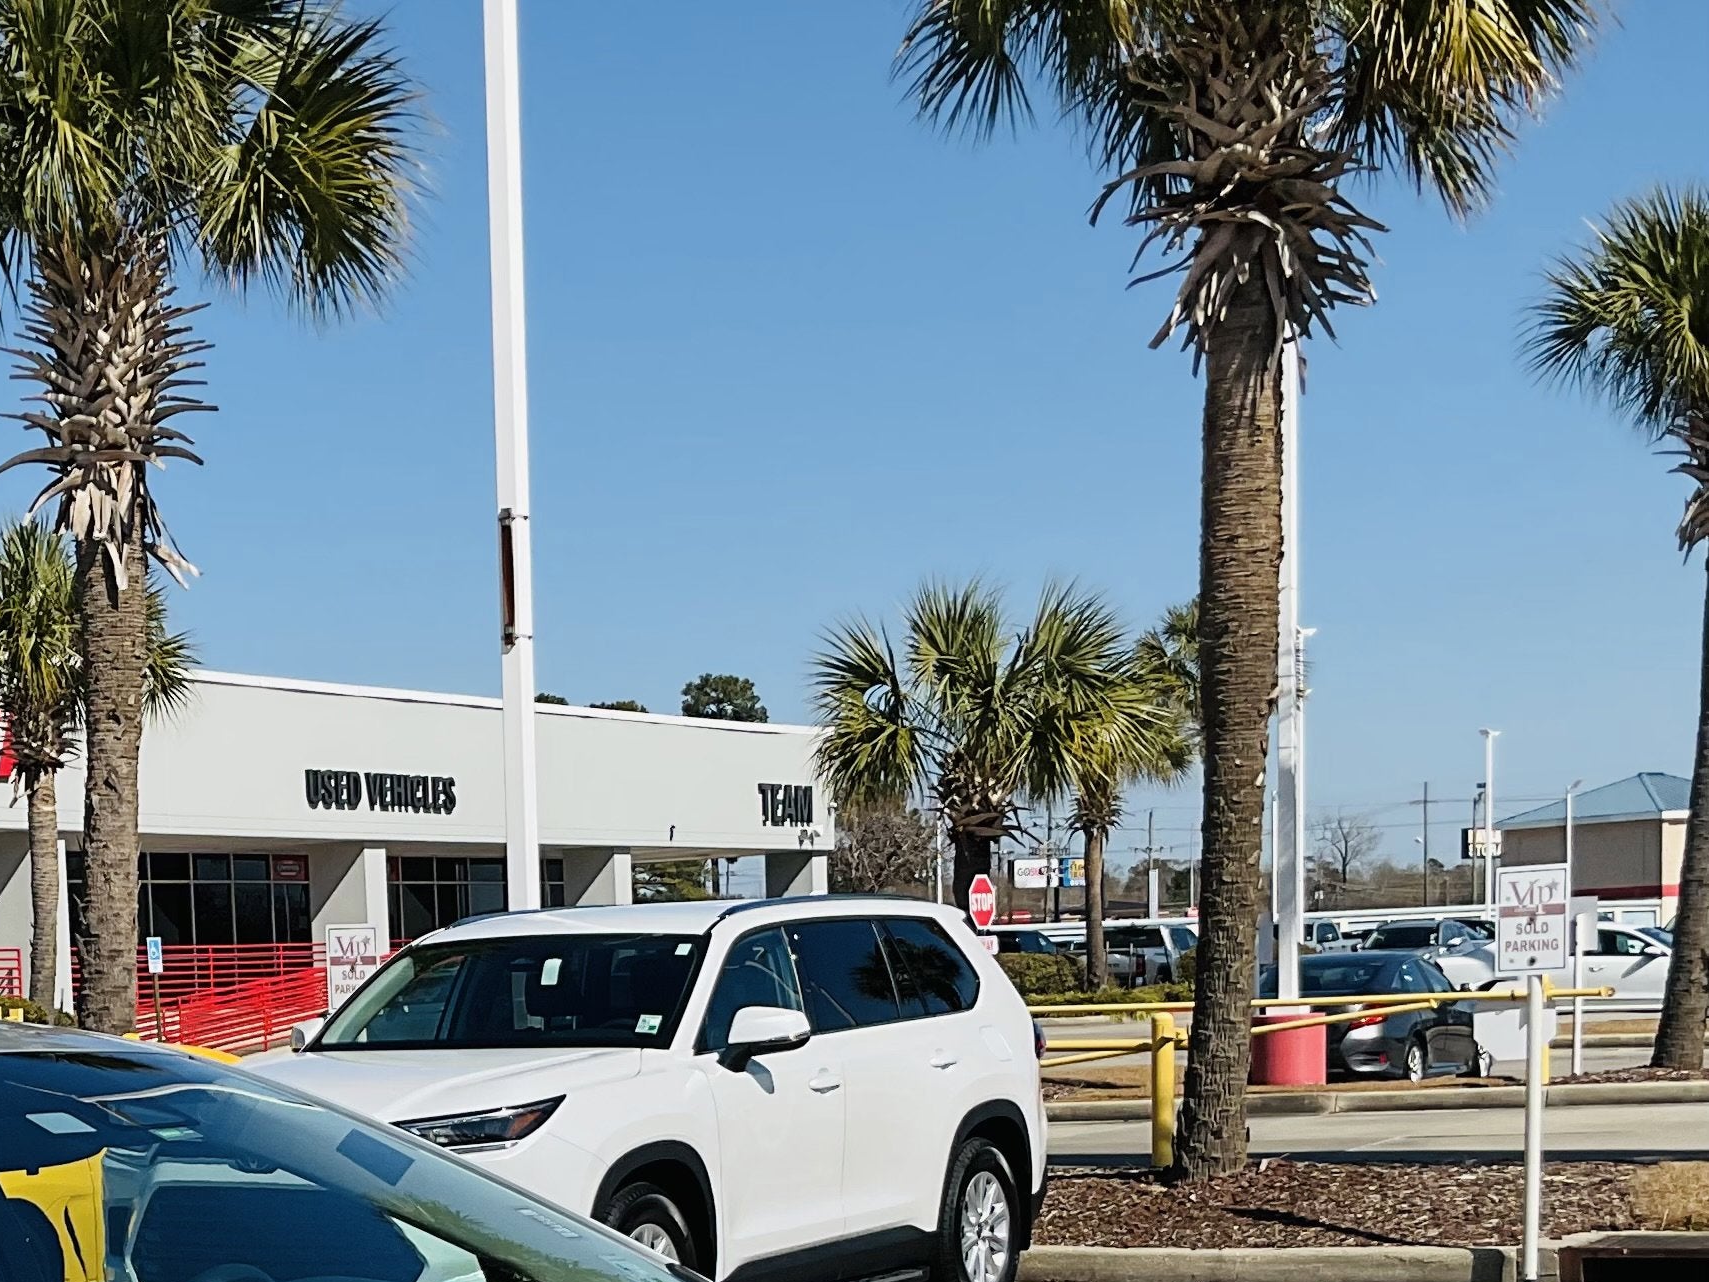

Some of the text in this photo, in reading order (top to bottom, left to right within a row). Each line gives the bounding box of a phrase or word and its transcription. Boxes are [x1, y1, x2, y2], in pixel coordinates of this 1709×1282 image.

[305, 769, 456, 815] USED VEHICLES
[757, 783, 813, 827] TEAM
[971, 893, 994, 911] STOP
[1516, 922, 1549, 935] SOLD
[1505, 939, 1559, 953] PARKING
[342, 970, 366, 981] SOLD
[335, 984, 356, 995] PARK
